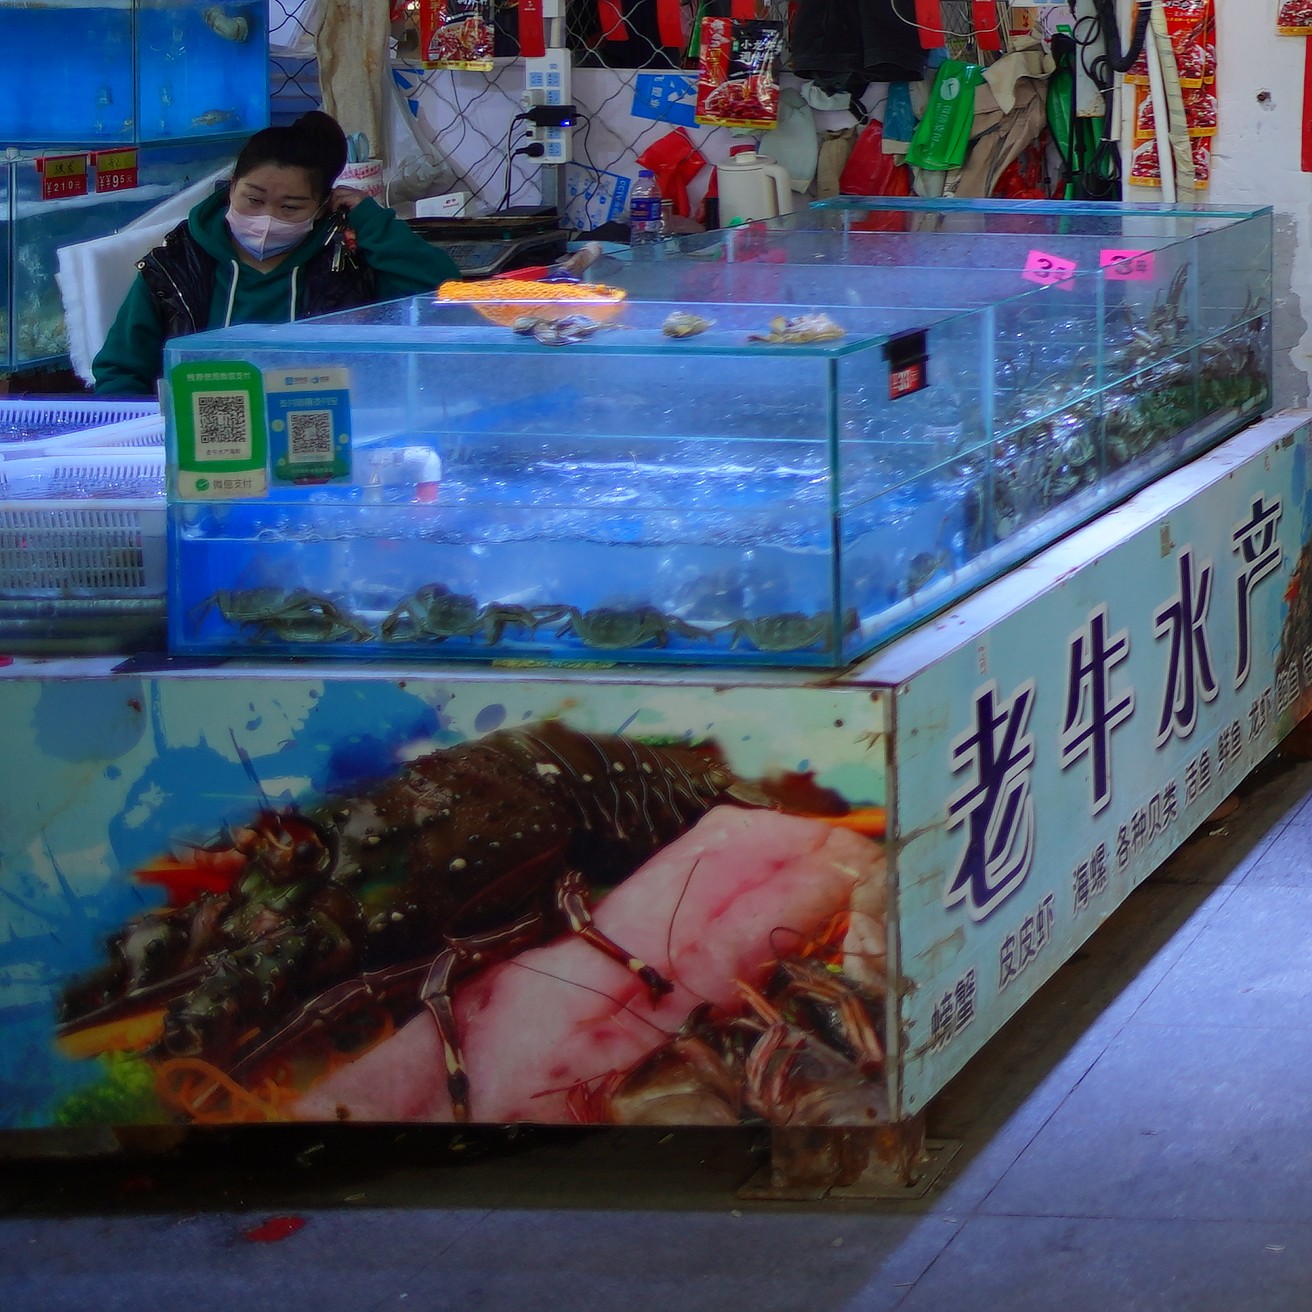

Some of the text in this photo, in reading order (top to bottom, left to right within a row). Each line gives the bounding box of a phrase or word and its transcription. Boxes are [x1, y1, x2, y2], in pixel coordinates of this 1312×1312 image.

[943, 496, 1284, 923] 老牛水产
[999, 891, 1056, 995] 皮皮虾
[1116, 778, 1178, 873] 各种贝类
